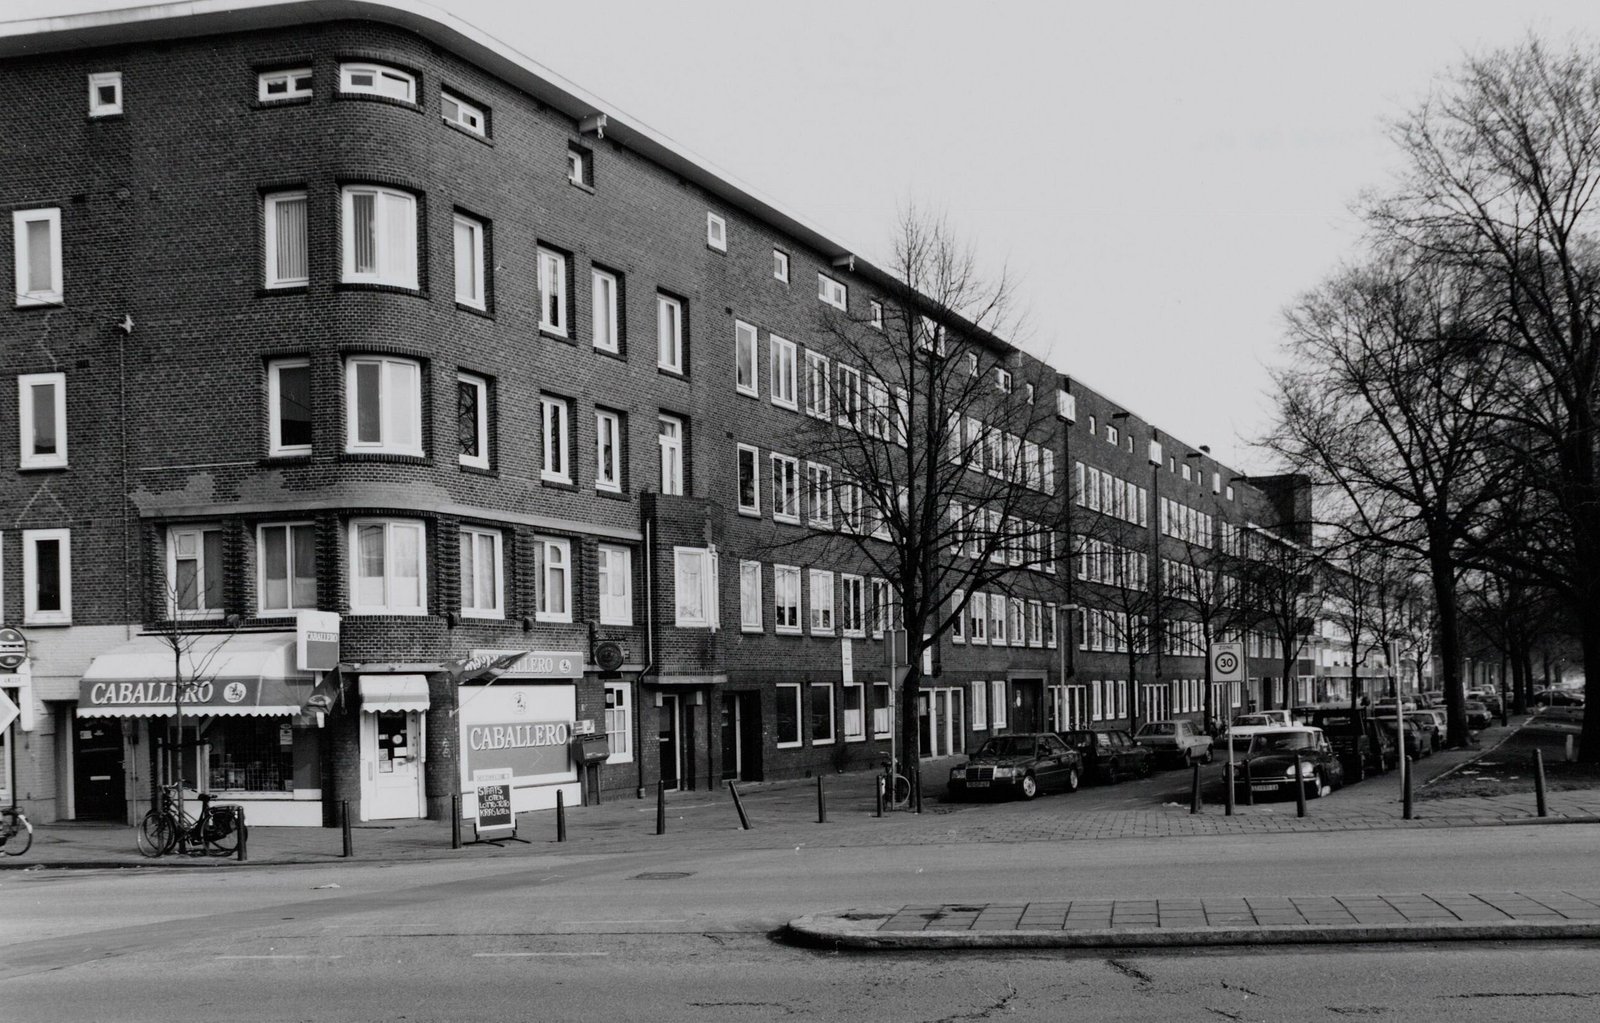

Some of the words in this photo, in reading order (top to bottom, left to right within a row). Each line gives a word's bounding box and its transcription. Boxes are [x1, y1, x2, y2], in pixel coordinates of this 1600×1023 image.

[1220, 658, 1233, 668] 30
[91, 681, 214, 705] CABALLERO
[470, 723, 567, 751] CABALLERO
